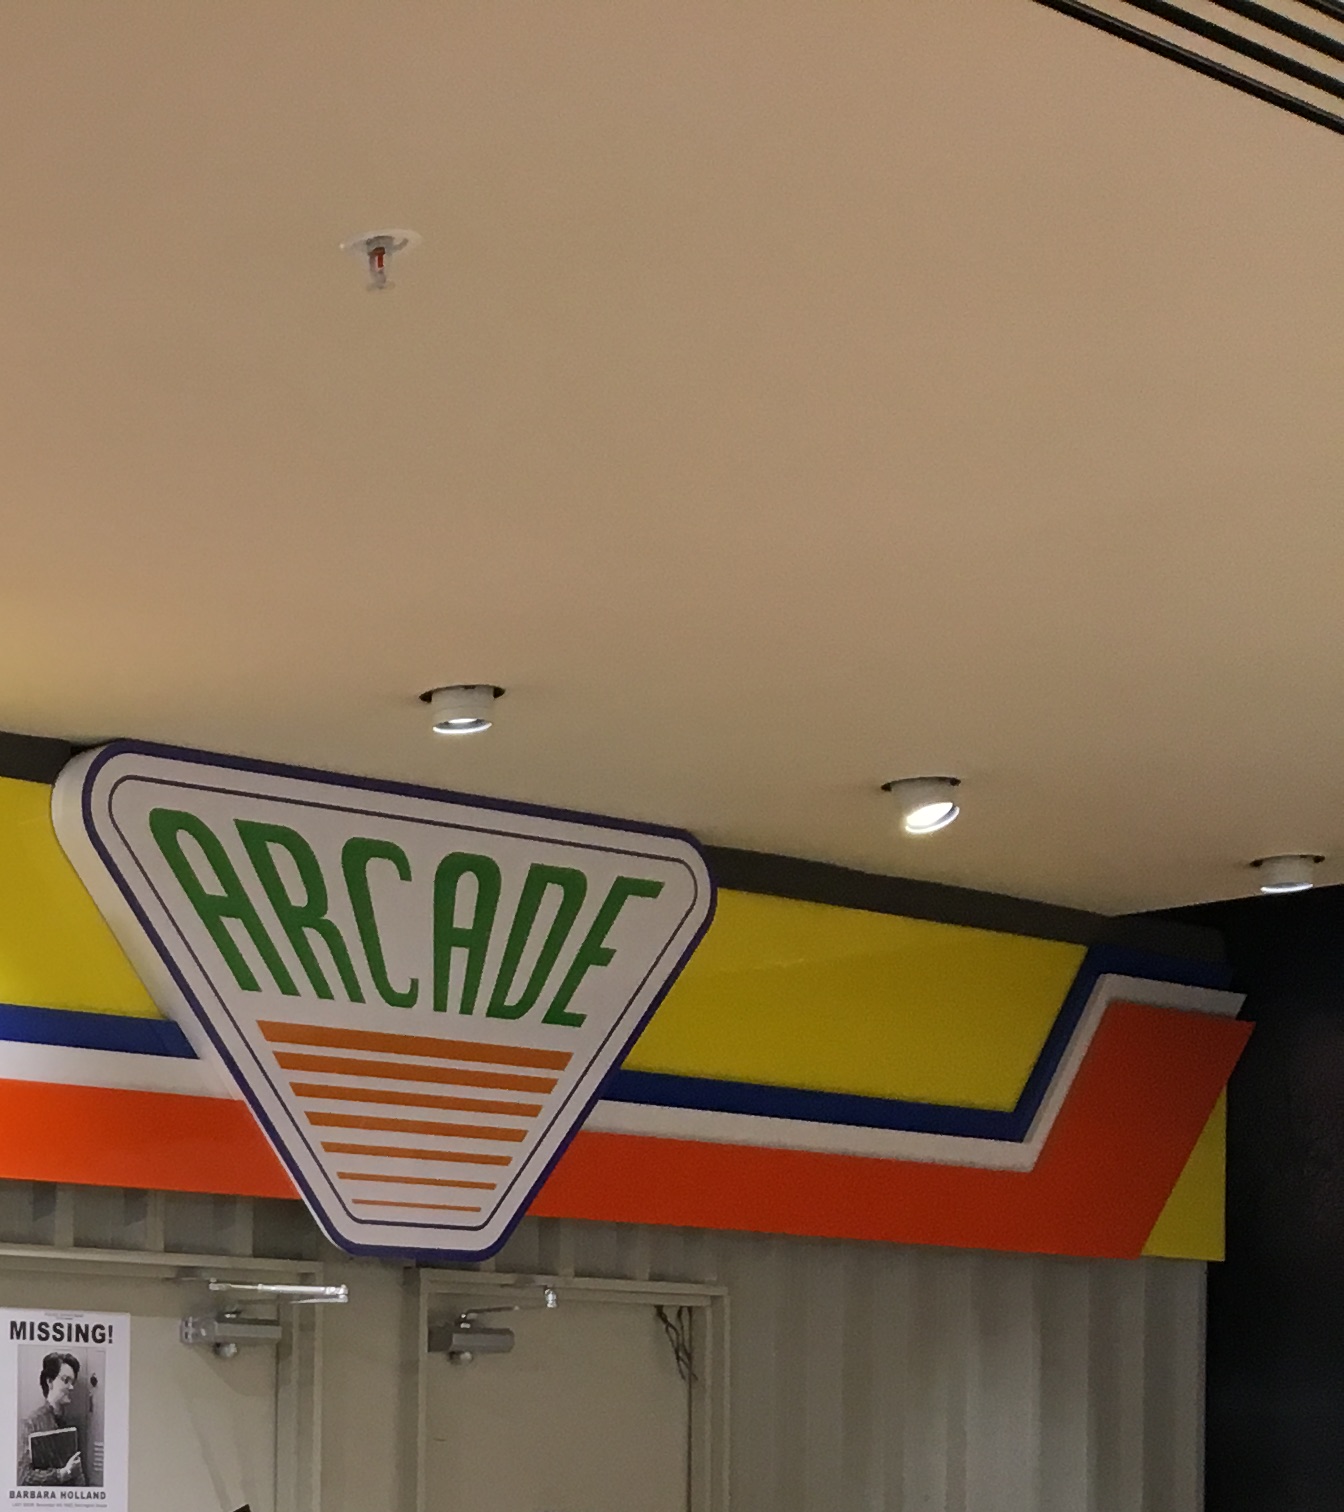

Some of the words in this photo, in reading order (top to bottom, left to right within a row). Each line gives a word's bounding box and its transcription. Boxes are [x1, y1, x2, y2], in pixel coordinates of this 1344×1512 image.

[149, 806, 665, 1028] ARCADE
[9, 1320, 114, 1345] MISSING!
[9, 1490, 57, 1500] BARBARA
[60, 1491, 107, 1500] HOLLAND
